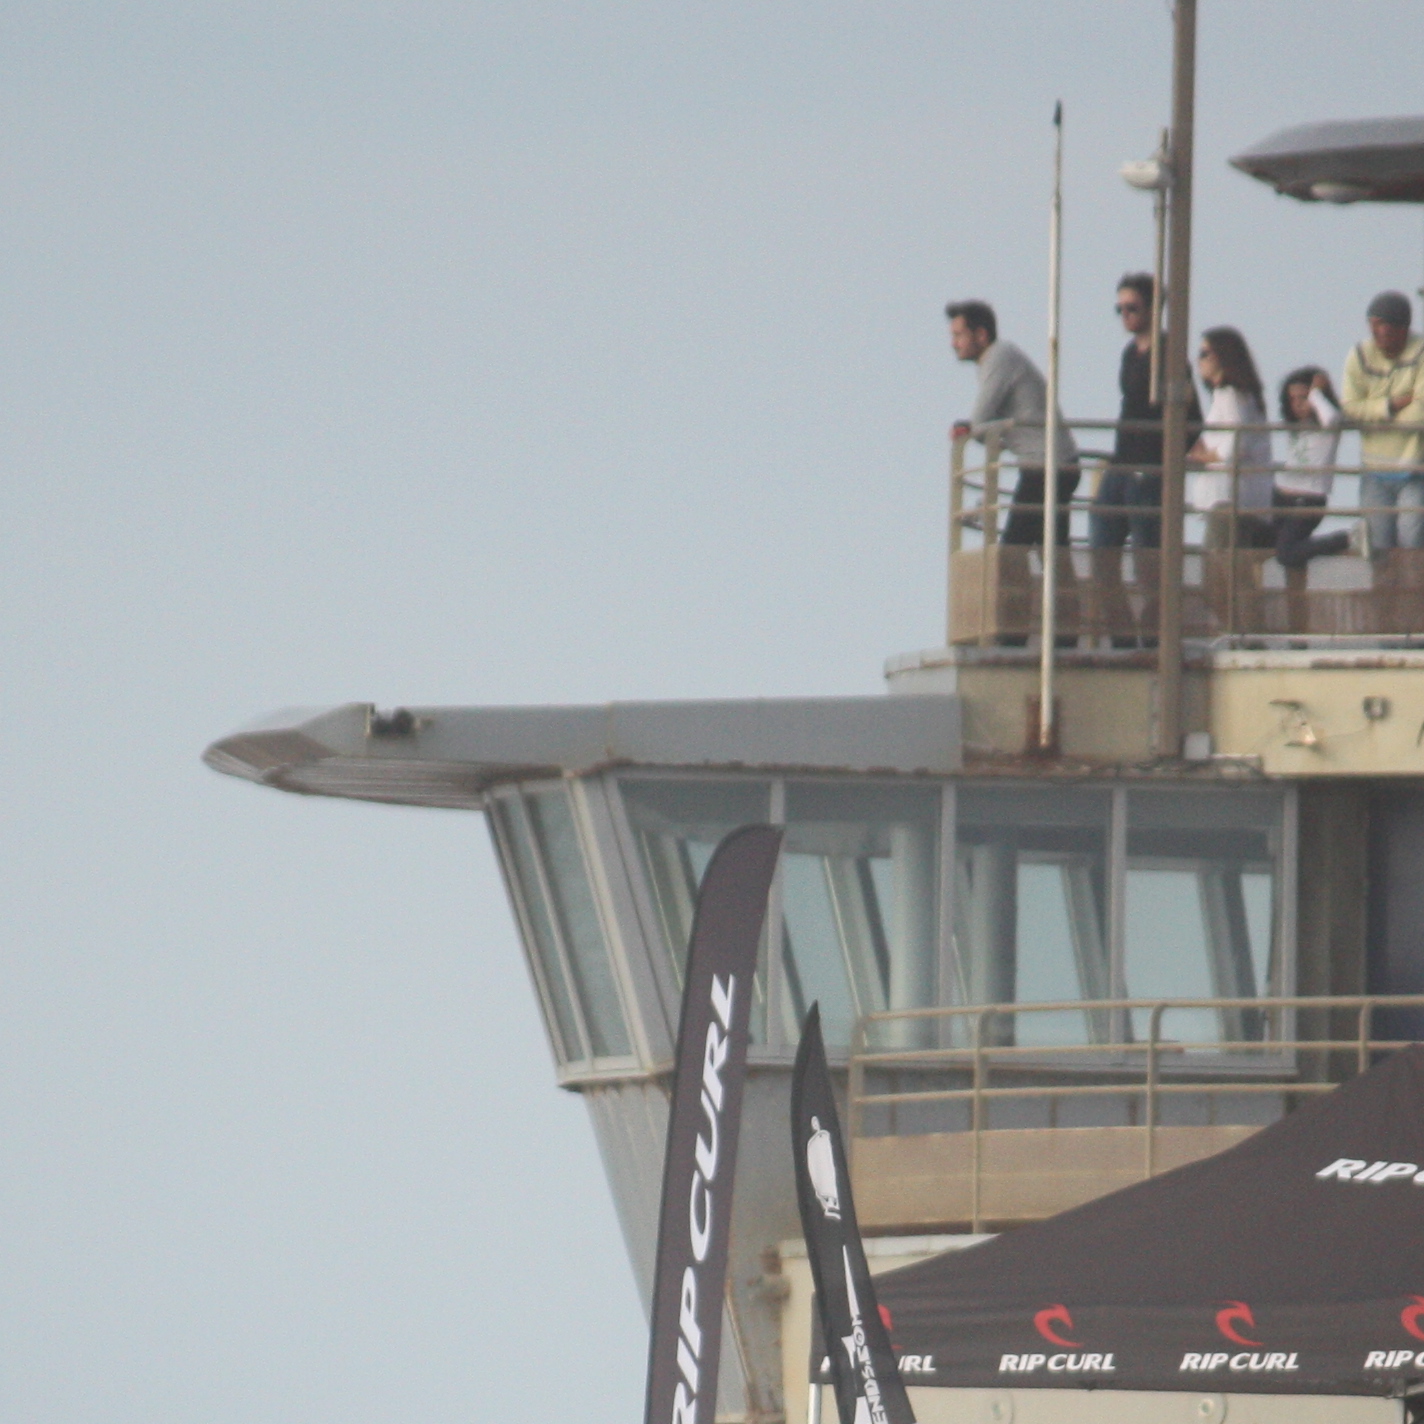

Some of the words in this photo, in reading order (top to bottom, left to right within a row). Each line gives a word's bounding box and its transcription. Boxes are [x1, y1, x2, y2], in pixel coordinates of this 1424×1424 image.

[689, 973, 736, 1262] CURL
[1316, 1157, 1419, 1186] RIP
[998, 1353, 1046, 1372] RIP
[1047, 1352, 1116, 1371] CURL
[1179, 1352, 1229, 1371] RIP
[1229, 1351, 1300, 1370] CURL
[1363, 1350, 1415, 1368] RIP
